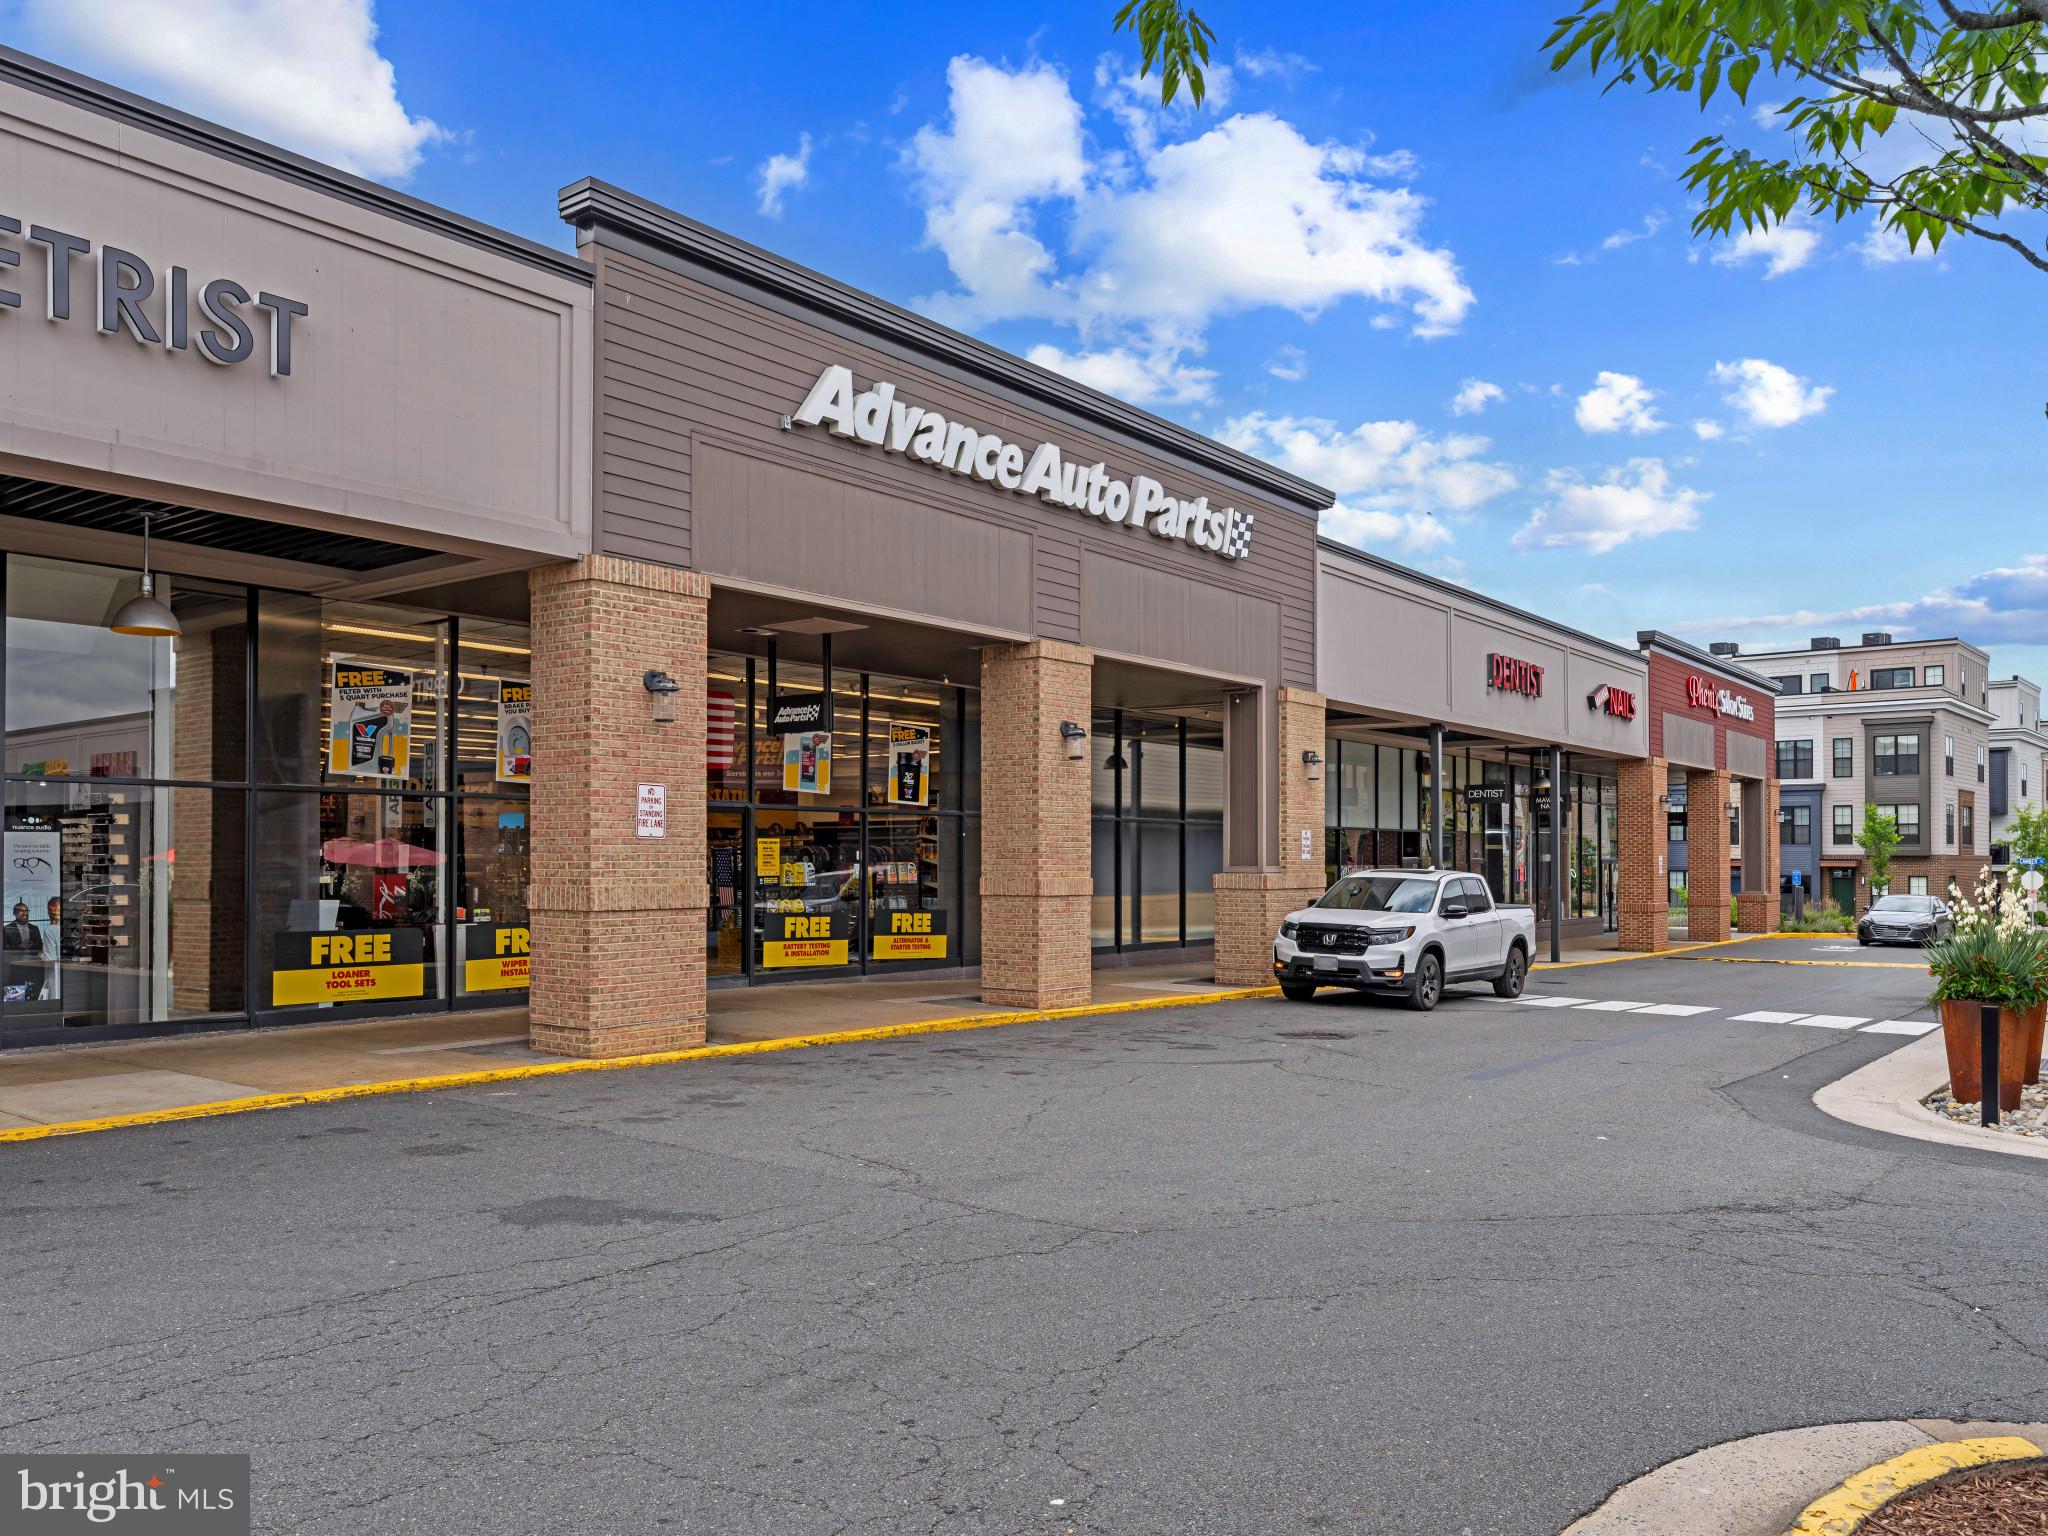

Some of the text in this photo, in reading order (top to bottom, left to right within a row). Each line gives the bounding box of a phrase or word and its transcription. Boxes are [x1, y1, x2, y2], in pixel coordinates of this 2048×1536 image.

[793, 364, 1026, 492] Advance
[1019, 441, 1131, 524] Auto
[336, 670, 385, 687] FREE
[1490, 652, 1545, 698] DENTIST
[345, 693, 370, 701] QUART
[371, 691, 408, 699] PURCHASE
[502, 687, 532, 702] FRE
[1607, 686, 1636, 721] NAILS
[779, 706, 807, 717] Advance
[773, 713, 807, 723] Auto Parts
[893, 729, 917, 741] FREE
[647, 787, 656, 796] NO
[1468, 789, 1504, 798] DENTIST
[640, 796, 663, 804] PARKING
[639, 809, 663, 818] STANDING
[638, 818, 664, 828] FIRE LANE
[784, 916, 831, 939] FREE
[891, 912, 932, 933] FREE
[495, 927, 531, 955] FR
[310, 933, 392, 965] FREE
[890, 943, 911, 951] STARTER
[790, 949, 830, 957] INSTALLATION
[501, 959, 528, 968] WIPER
[332, 969, 370, 980] LOANER
[500, 967, 531, 977] INSTAL
[325, 978, 377, 989] TOOL SETS
